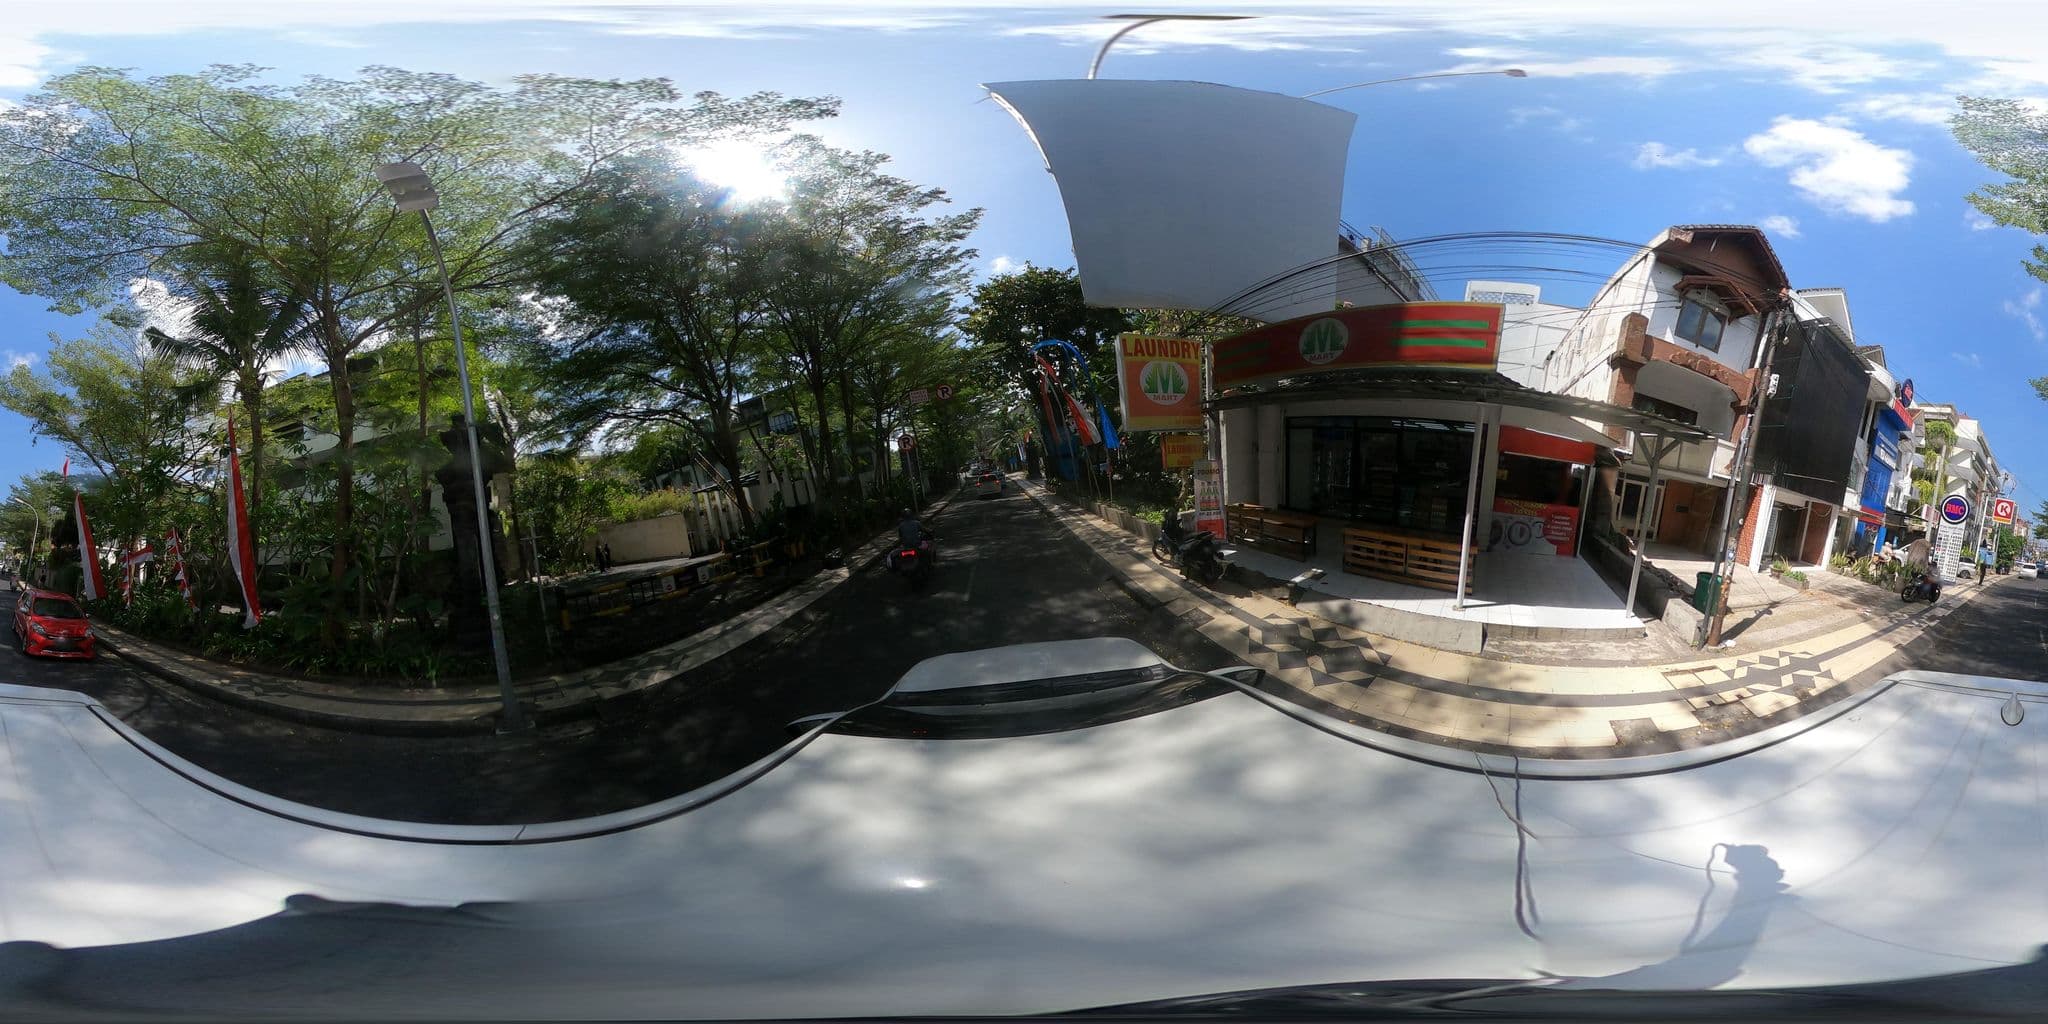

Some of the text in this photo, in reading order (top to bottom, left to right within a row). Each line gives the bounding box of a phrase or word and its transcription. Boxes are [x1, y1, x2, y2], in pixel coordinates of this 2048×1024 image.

[1121, 338, 1201, 360] LAUNDRY
[1311, 351, 1334, 361] MART
[1945, 503, 1965, 515] BMC
[2000, 504, 2009, 514] K
